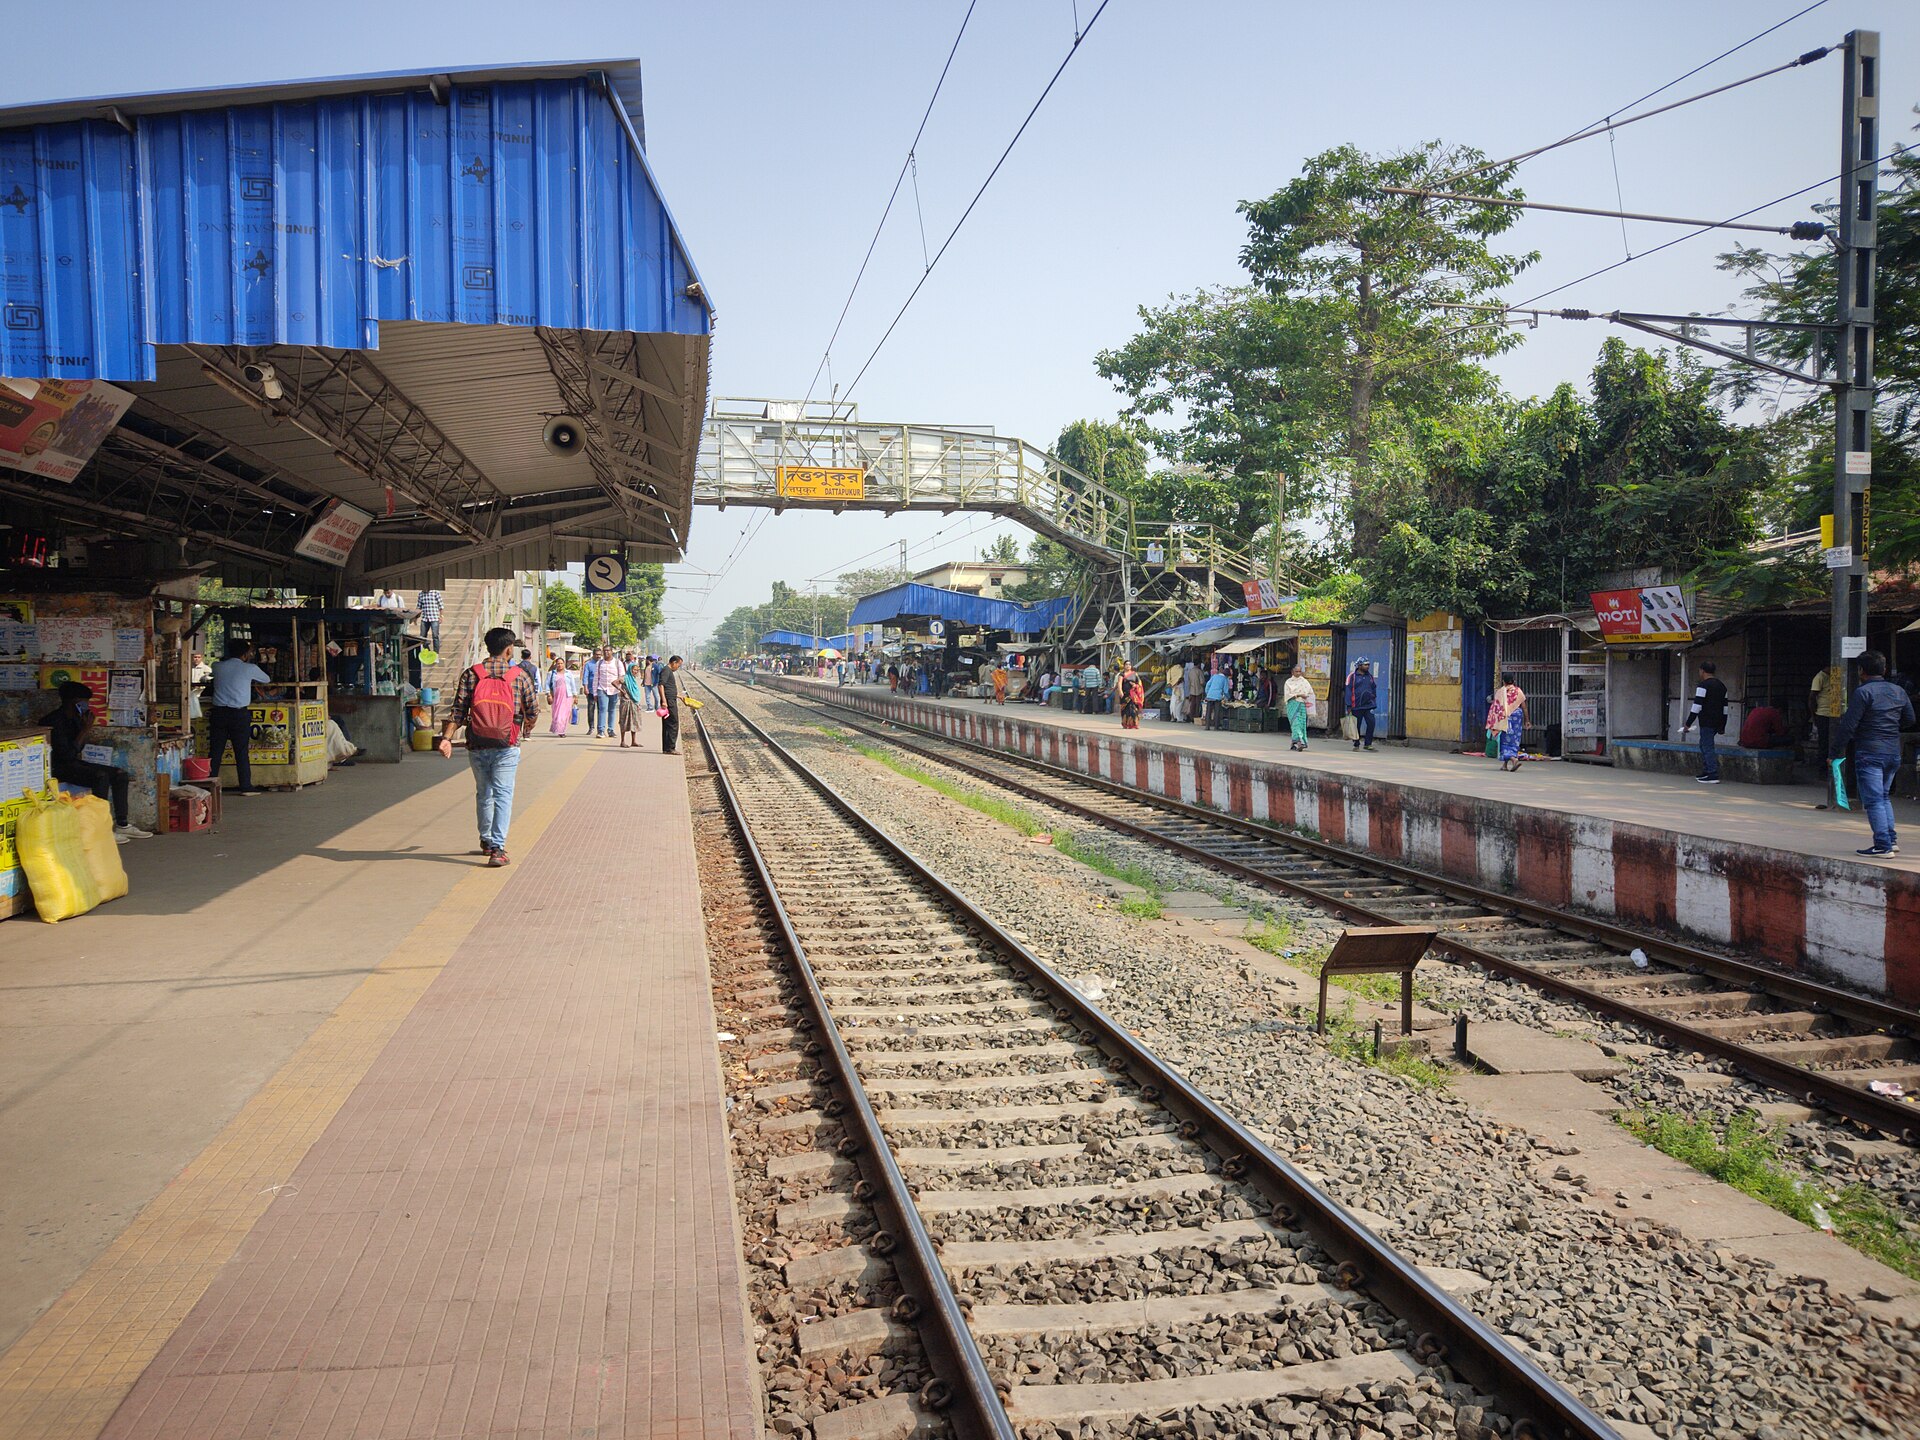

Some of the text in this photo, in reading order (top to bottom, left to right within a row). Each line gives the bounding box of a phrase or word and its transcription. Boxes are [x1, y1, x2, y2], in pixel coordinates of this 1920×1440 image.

[824, 488, 861, 496] DATTAPUKUR
[934, 623, 938, 633] 1
[307, 721, 324, 737] CRORE
